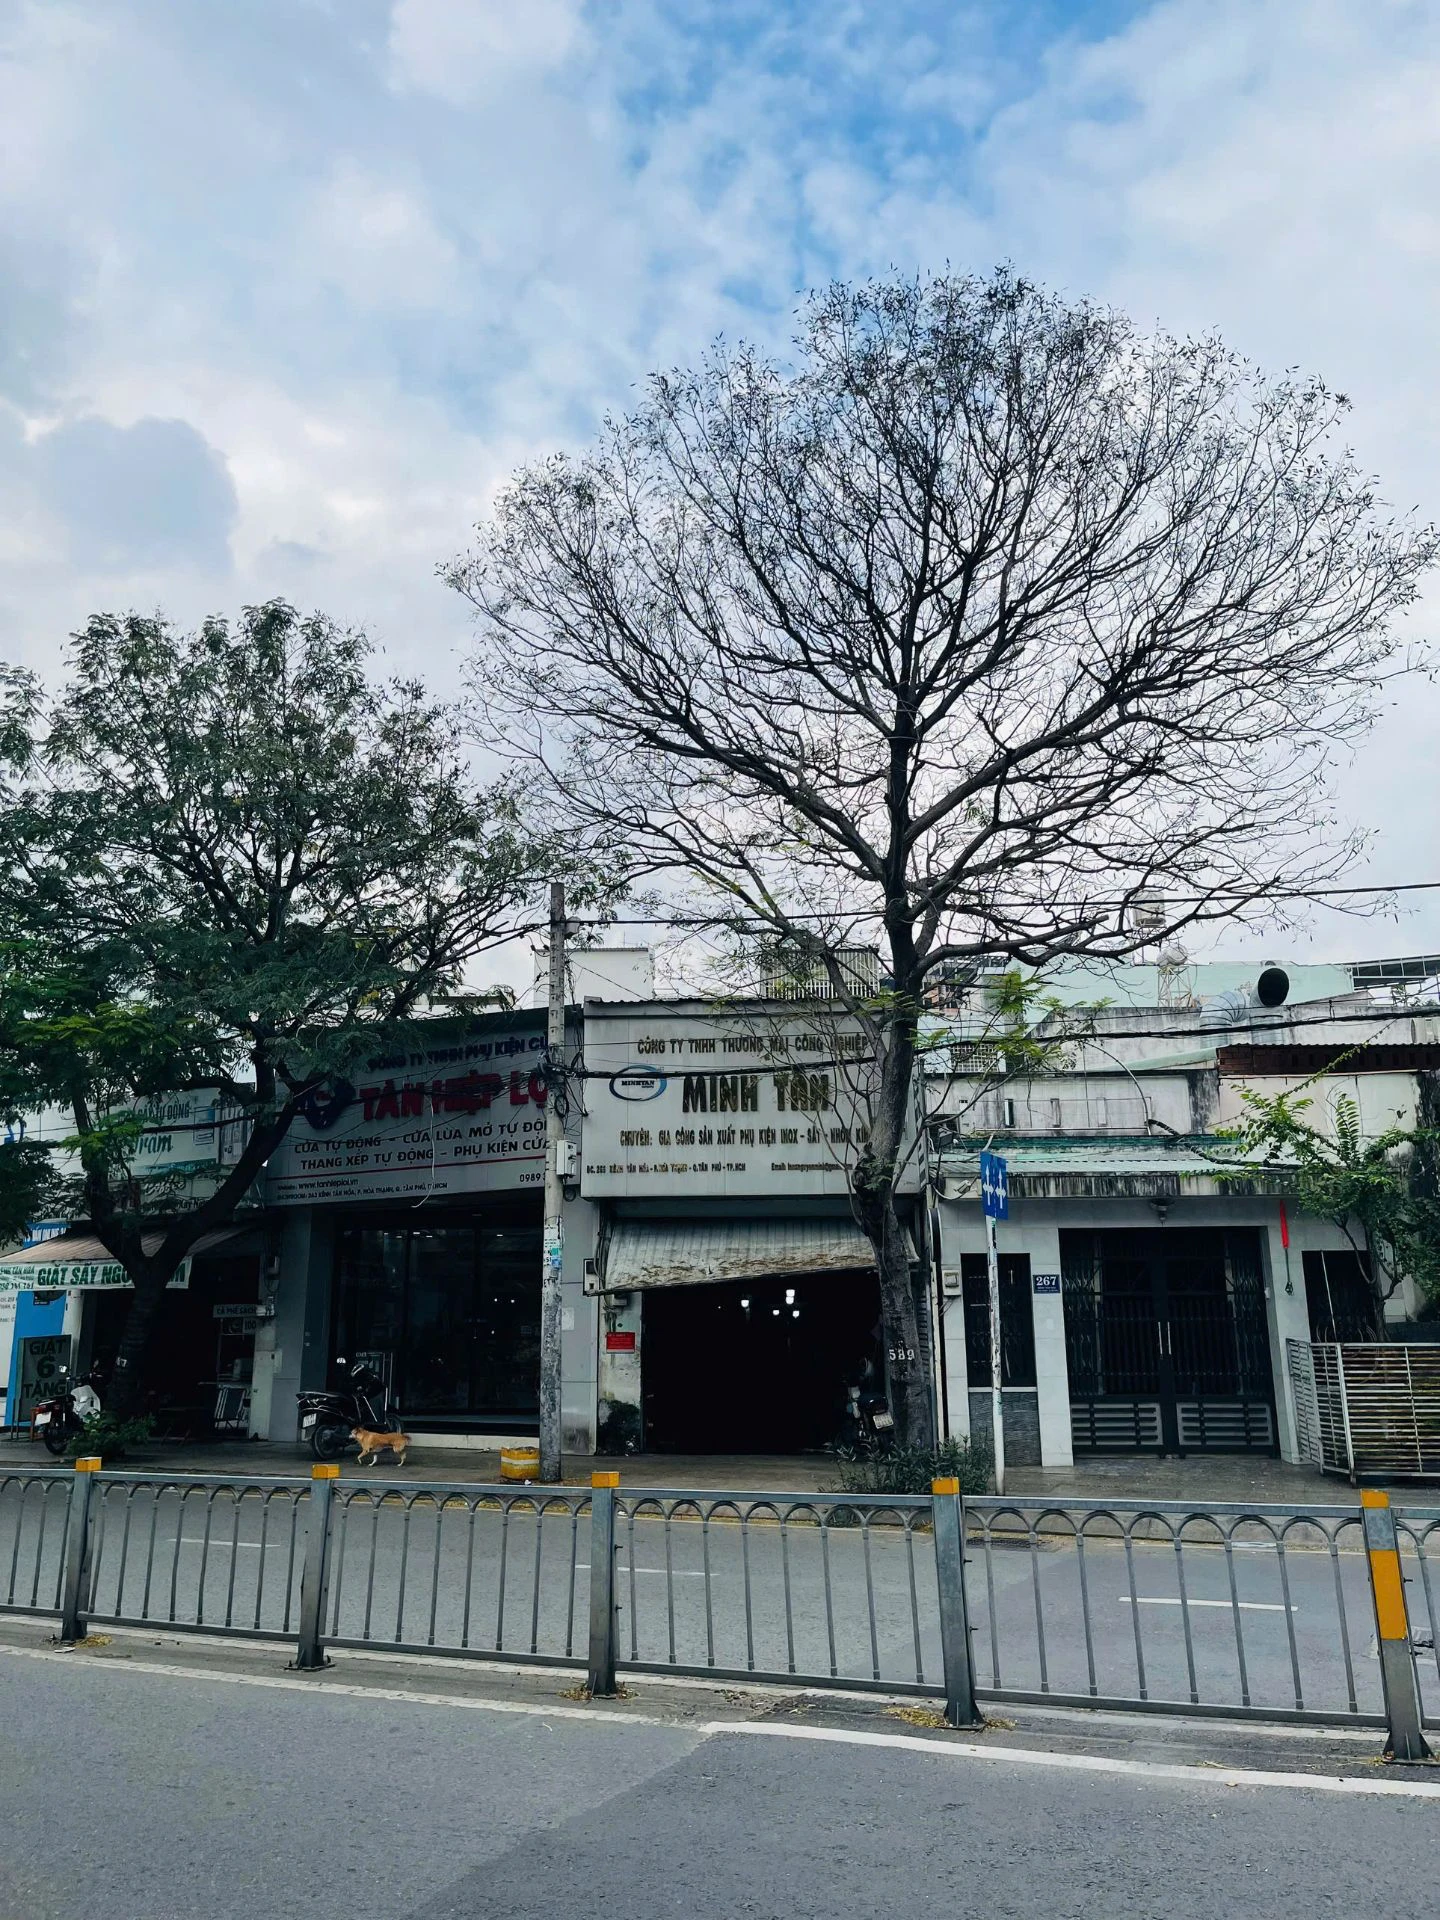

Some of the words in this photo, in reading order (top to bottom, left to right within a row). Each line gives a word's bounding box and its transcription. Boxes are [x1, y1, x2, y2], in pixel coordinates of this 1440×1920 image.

[638, 1036, 665, 1054] CÔNG
[670, 1038, 684, 1053] TY
[688, 1038, 715, 1053] TNHH
[795, 1034, 823, 1050] CÔNG
[359, 1078, 425, 1121] TÂN
[682, 1074, 758, 1112] MINH
[346, 1136, 381, 1152] ĐỘNG
[436, 1127, 462, 1141] LÙA
[469, 1122, 492, 1138] MỞ
[499, 1122, 518, 1138] TỰ
[523, 1119, 547, 1135] ĐỘ
[620, 1128, 652, 1146] CHUYÊN:
[659, 1130, 671, 1145] GIA
[676, 1126, 694, 1144] CÔNG
[698, 1125, 712, 1144] SẢN
[717, 1124, 736, 1144] XUẤT
[740, 1129, 754, 1147] PHỤ
[759, 1126, 776, 1147] KIỆN
[781, 1128, 798, 1144] INOX
[301, 1157, 342, 1170] THANG
[346, 1151, 368, 1166] XẾP
[374, 1152, 392, 1167] TỰ
[397, 1147, 433, 1164] ĐỘNG
[454, 1144, 482, 1159] PHỤ
[488, 1138, 518, 1157] KIỆN
[38, 1264, 68, 1288] GIẶT
[70, 1262, 100, 1285] SẤY
[1036, 1276, 1056, 1286] 267
[37, 1356, 55, 1378] 6
